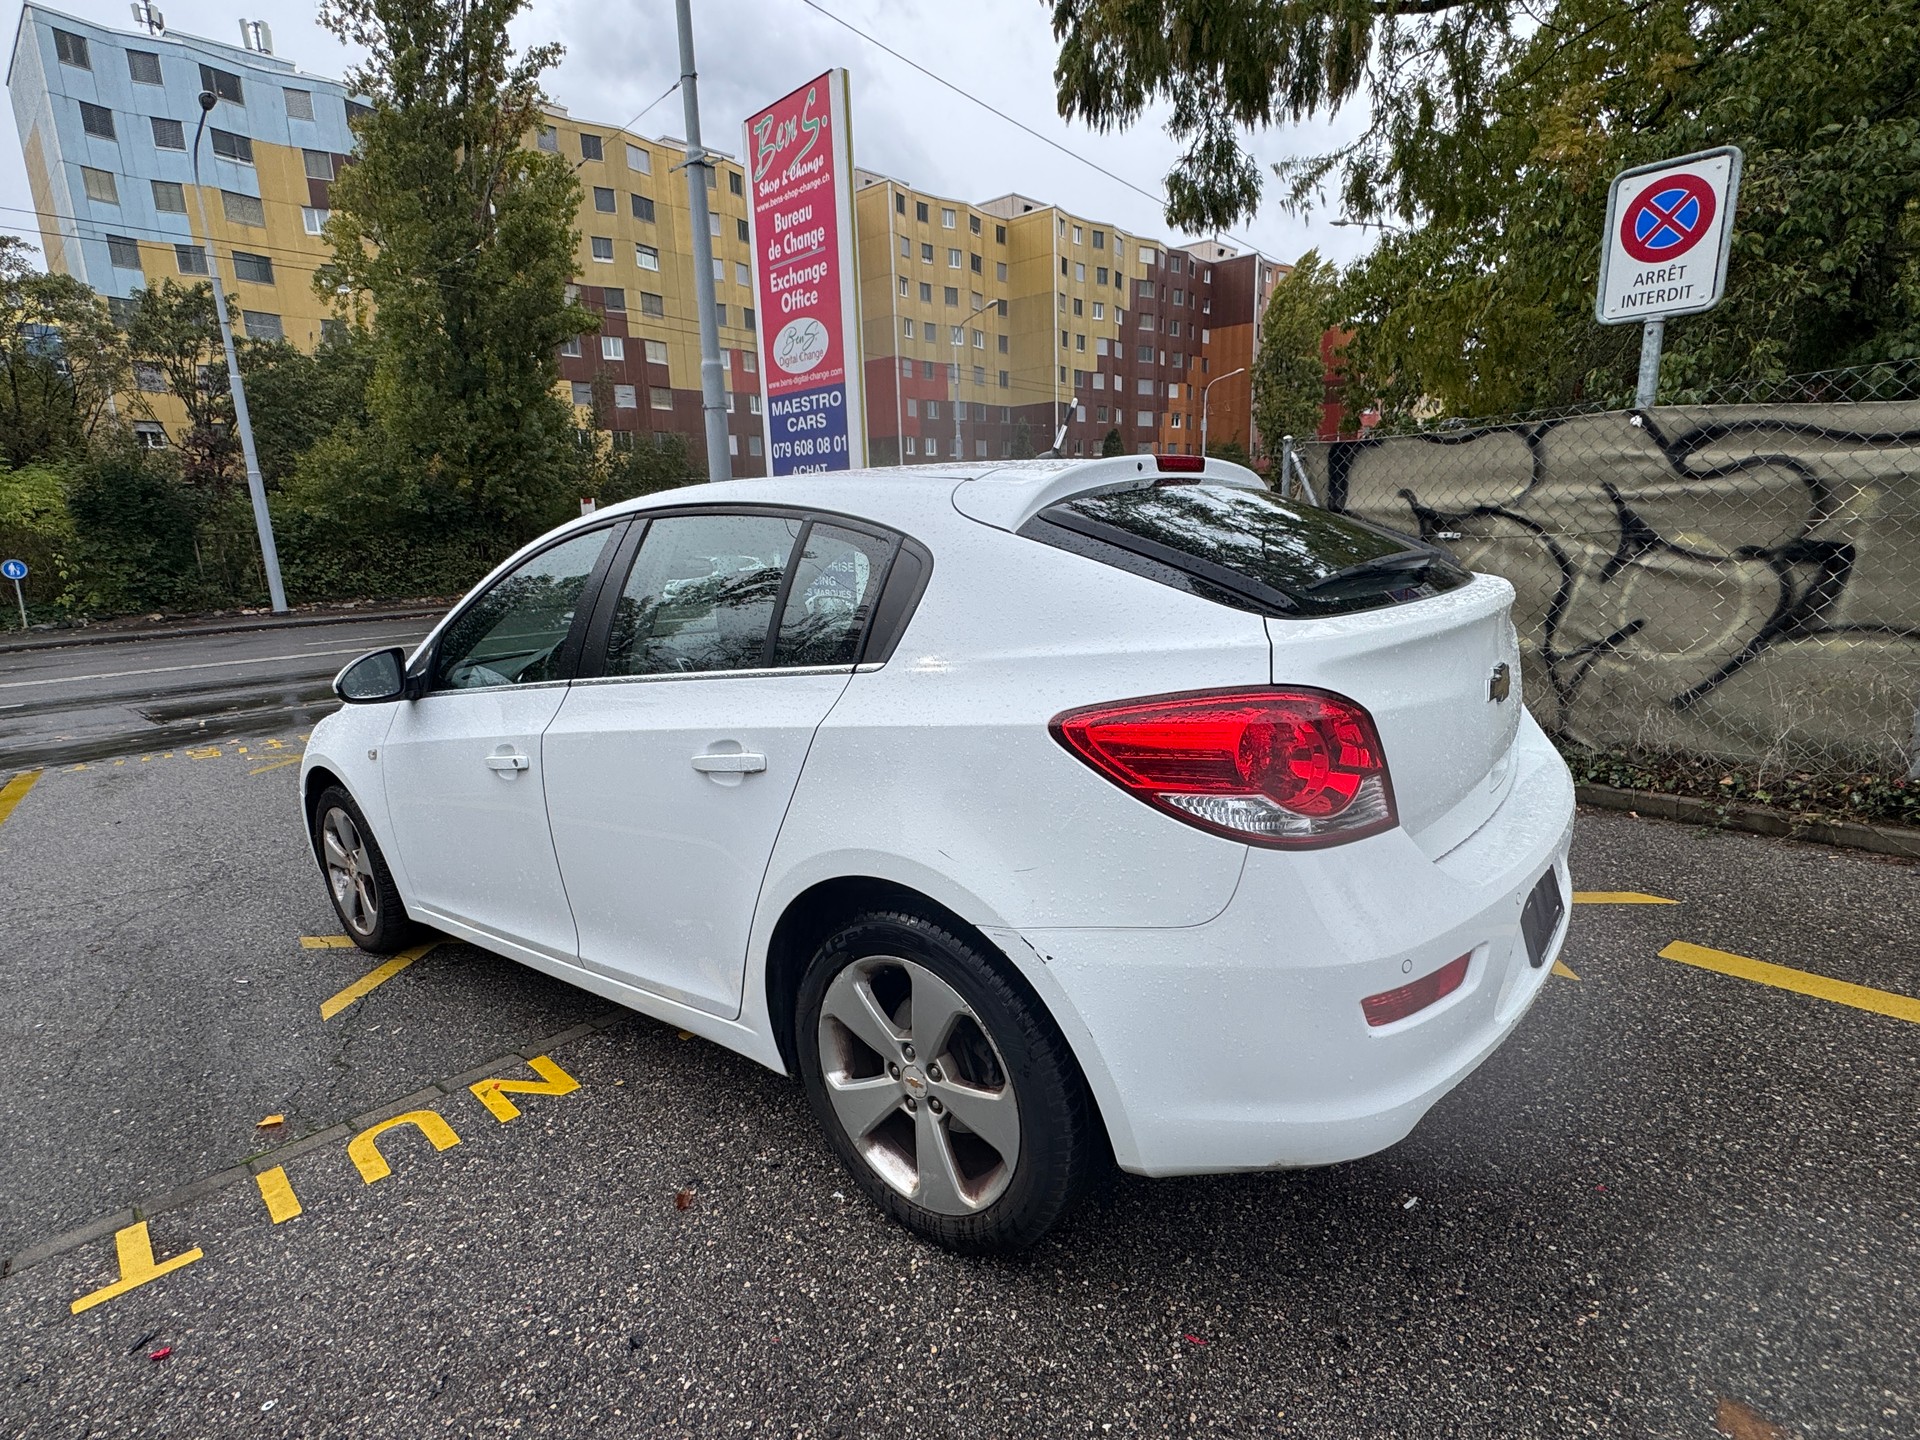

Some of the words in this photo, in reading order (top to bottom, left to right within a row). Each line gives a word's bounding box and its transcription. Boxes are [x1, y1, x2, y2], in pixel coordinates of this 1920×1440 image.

[759, 178, 780, 197] Shop
[782, 169, 789, 186] &
[789, 154, 824, 181] Change
[756, 172, 830, 213] www.bens-shop-change.ch
[774, 204, 812, 234] Bureau
[768, 239, 781, 261] de
[783, 226, 825, 255] Change
[770, 261, 828, 293] Exchange
[1633, 264, 1688, 288] ARRÊT
[781, 288, 818, 313] Office
[1621, 284, 1694, 309] INTERDIT
[779, 353, 798, 368] Digital
[799, 348, 824, 362] Change
[768, 367, 843, 390] www.bens-digital-change.com
[771, 390, 842, 417] MAESTRO
[787, 412, 827, 433] CARS
[773, 441, 792, 459] 079
[794, 439, 814, 457] 608
[816, 436, 831, 454] 08
[833, 434, 847, 453] 01
[792, 463, 828, 476] ACHAT
